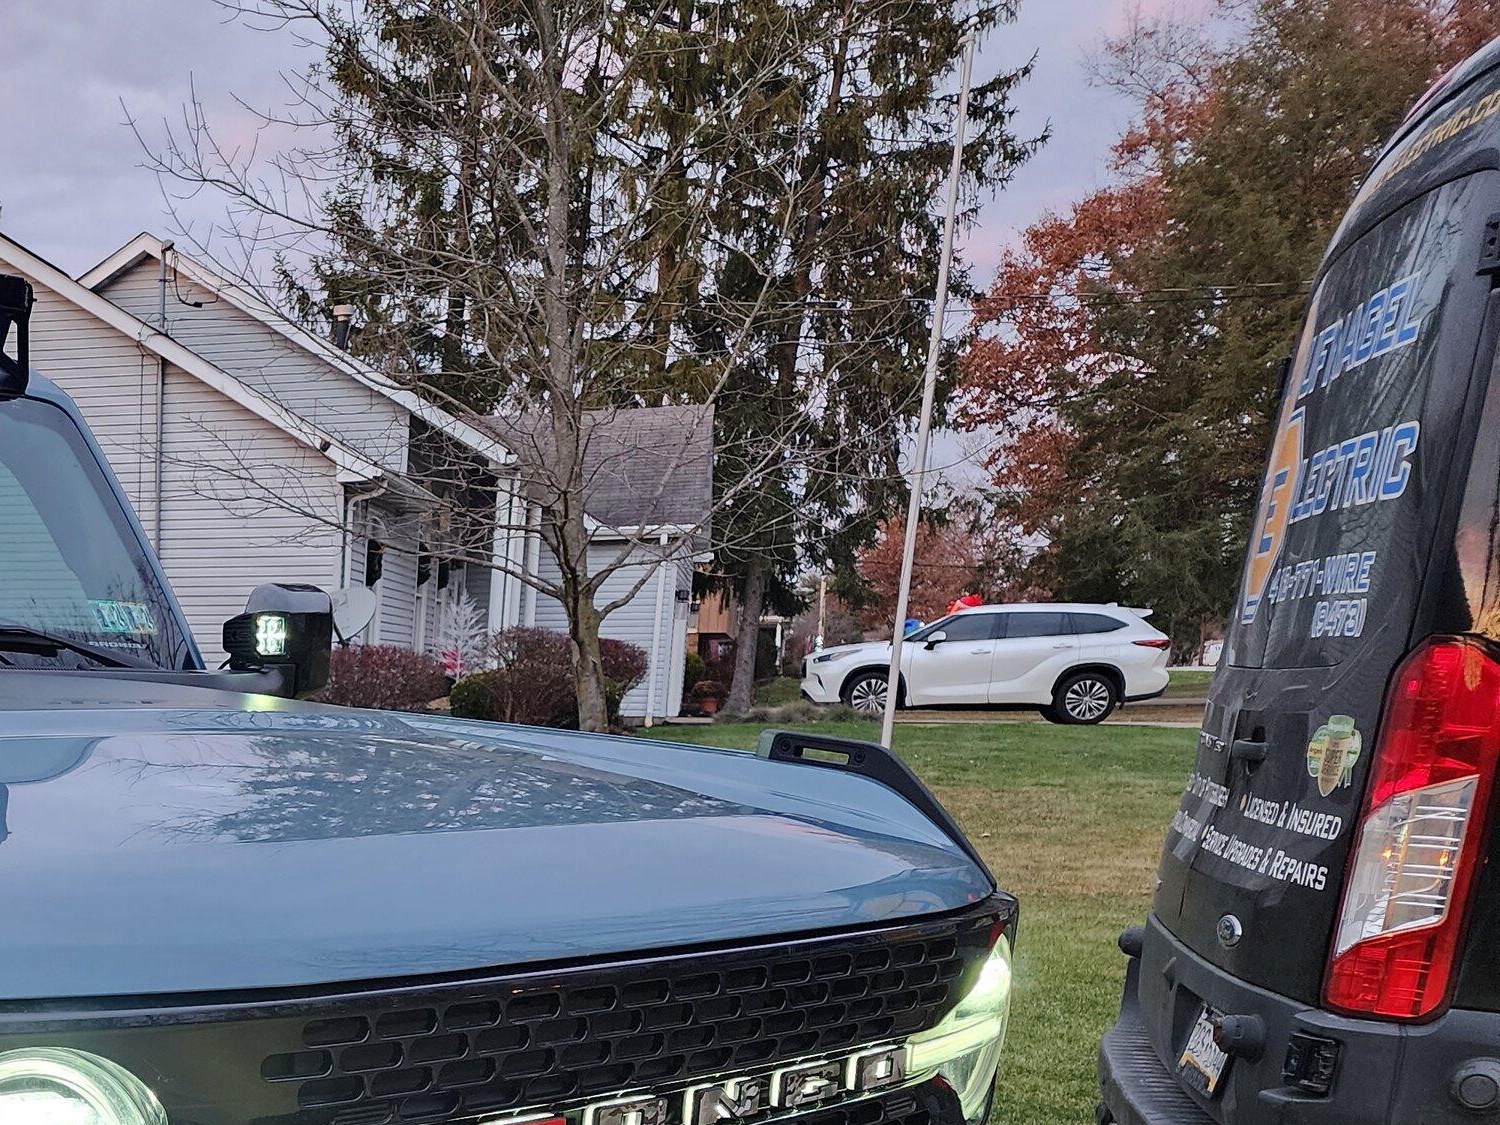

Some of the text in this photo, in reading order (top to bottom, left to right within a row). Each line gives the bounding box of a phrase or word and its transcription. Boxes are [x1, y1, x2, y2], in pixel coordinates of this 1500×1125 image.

[1277, 801, 1289, 828] &
[1286, 802, 1342, 840] INSURED
[1258, 847, 1273, 874] &
[1268, 850, 1329, 891] REPAIRS
